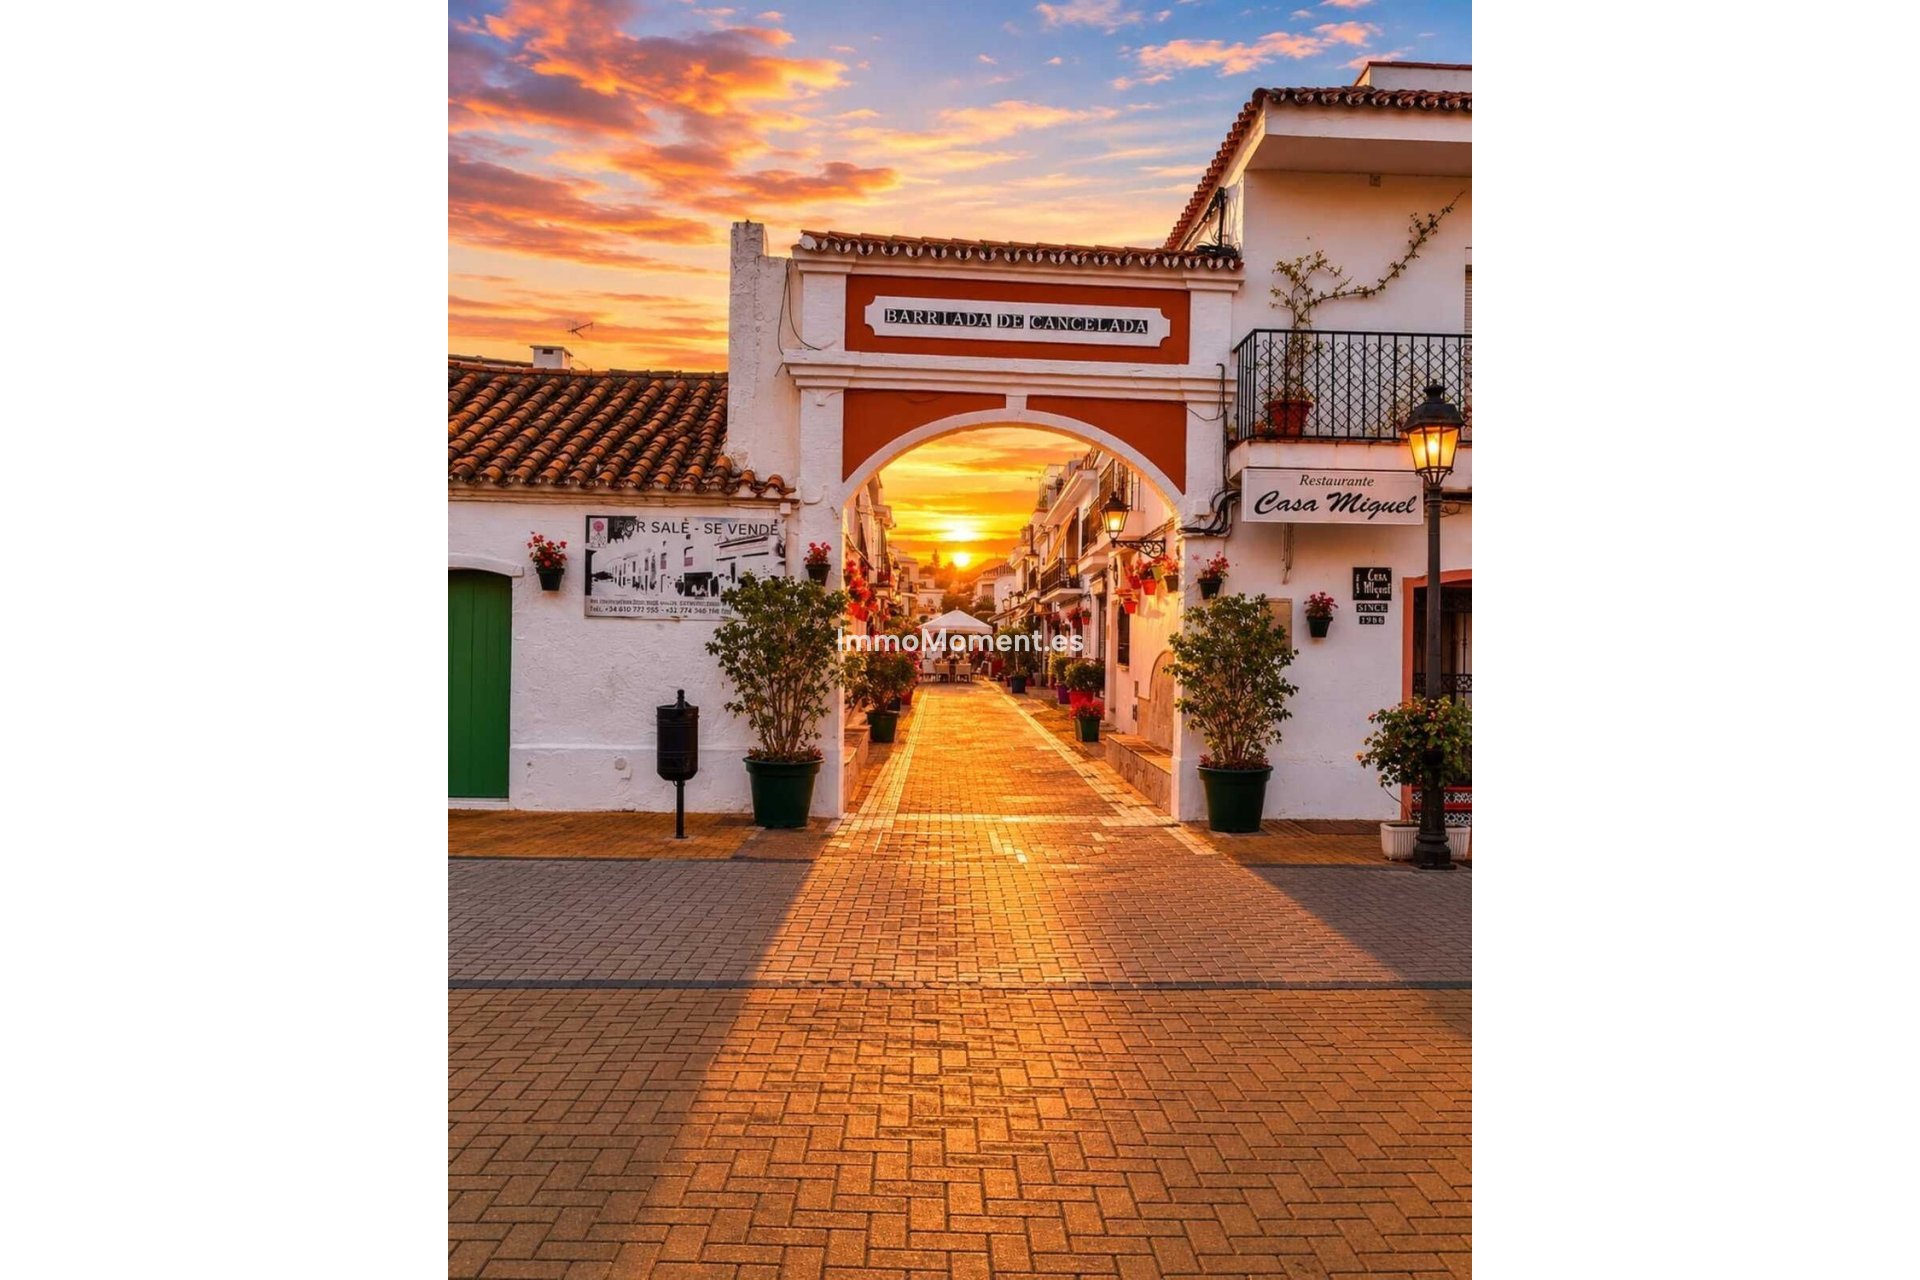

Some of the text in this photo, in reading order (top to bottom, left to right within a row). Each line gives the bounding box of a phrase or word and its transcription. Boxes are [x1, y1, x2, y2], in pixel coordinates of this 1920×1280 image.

[885, 309, 1148, 334] BARRIADA DE CANCELADA
[1299, 474, 1375, 488] Restaurante
[1254, 490, 1418, 520] Casa Miguel
[614, 520, 646, 533] FOR
[651, 521, 689, 534] SALE
[704, 522, 722, 535] SE
[728, 523, 779, 536] VENDE
[1358, 604, 1386, 612] SINCE
